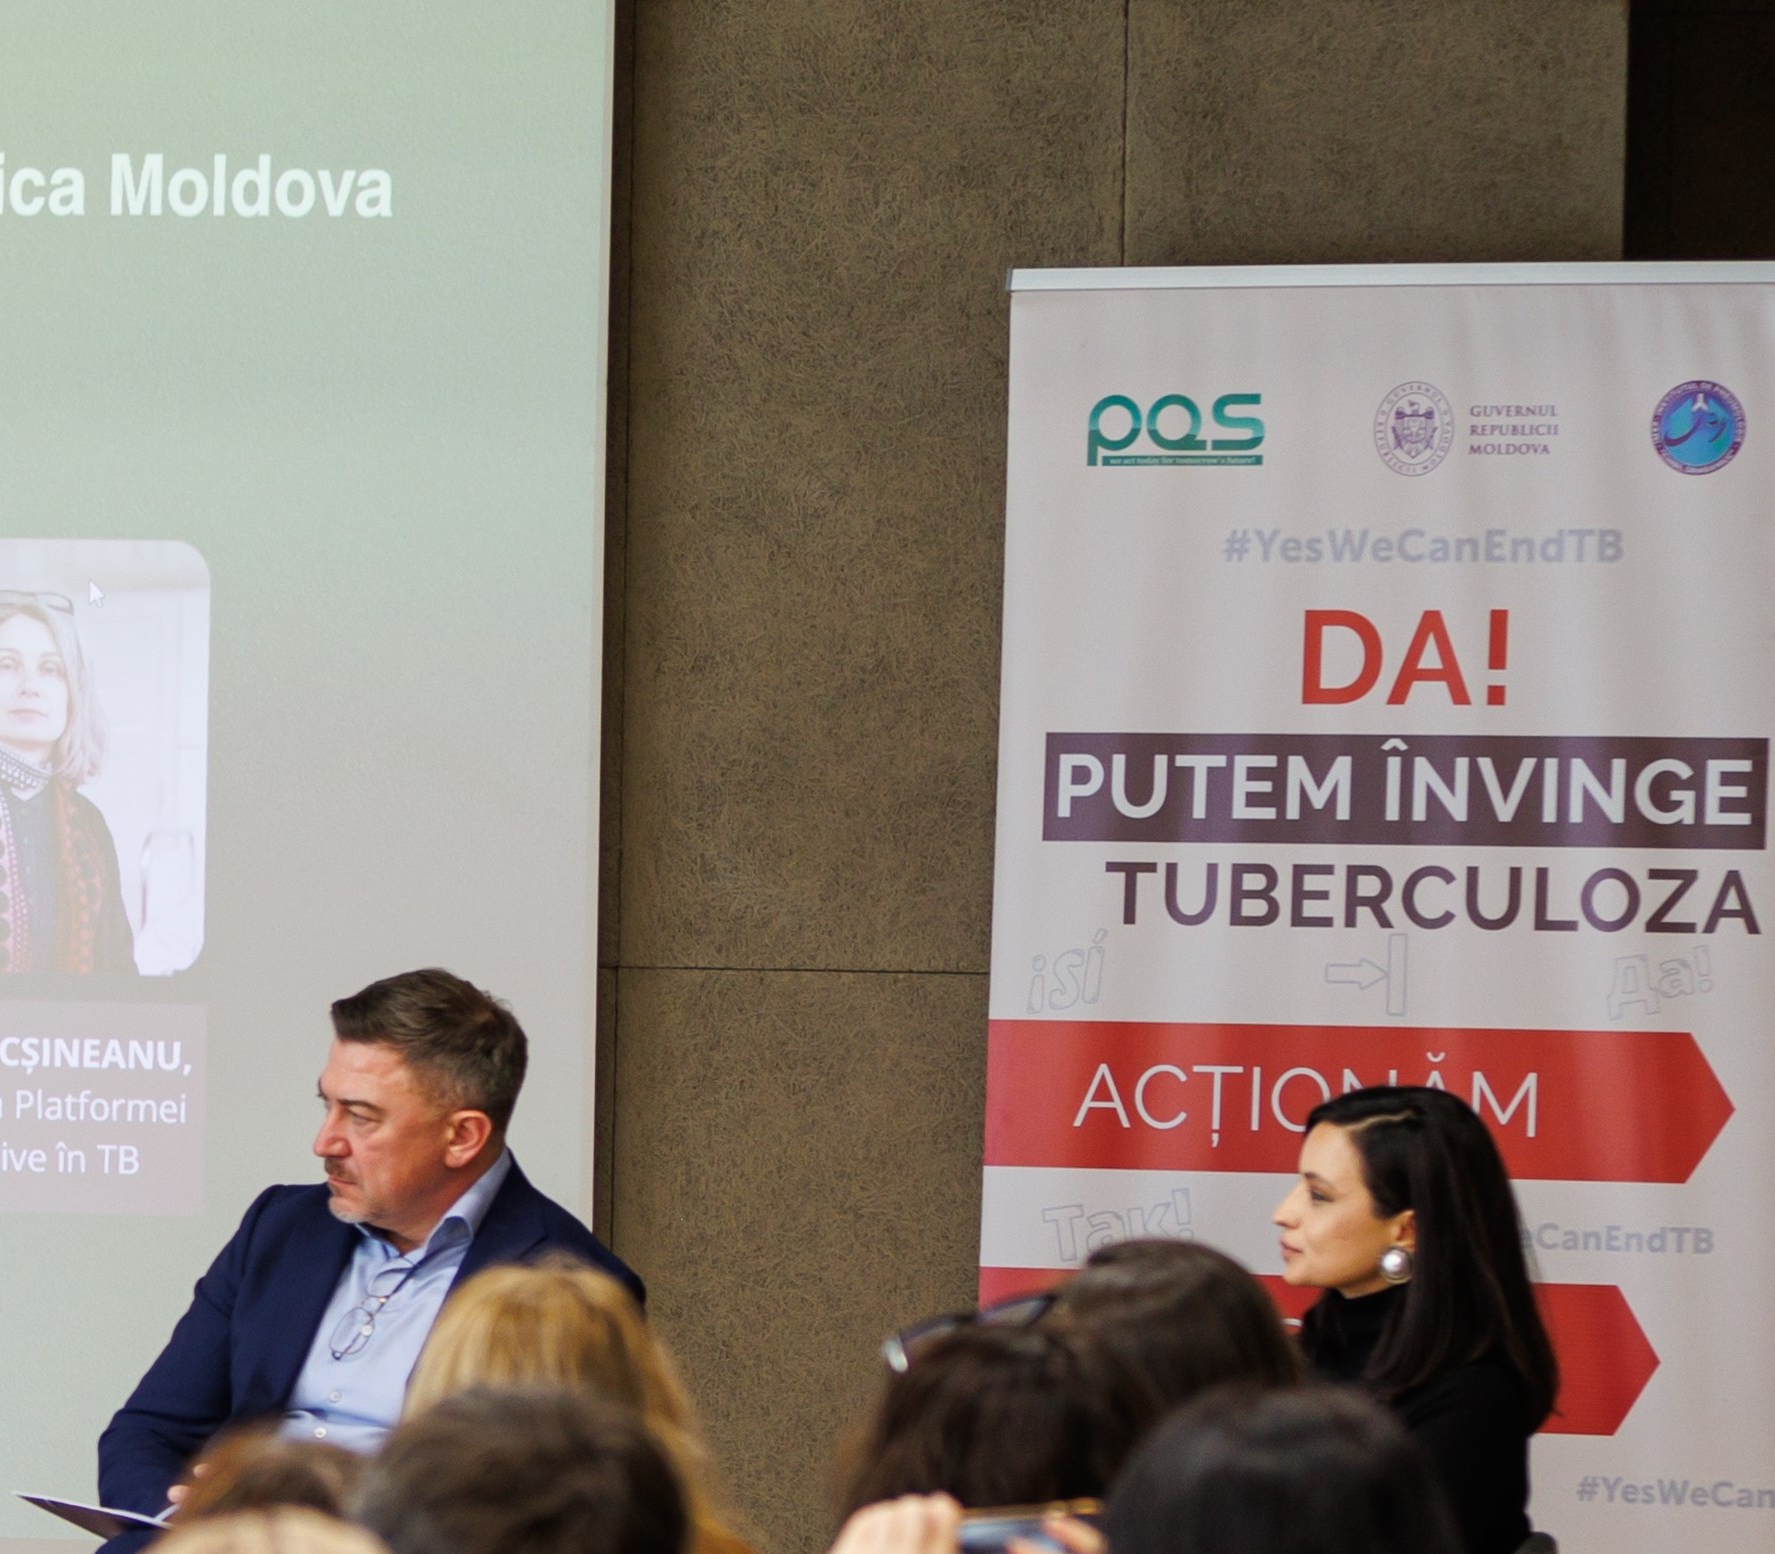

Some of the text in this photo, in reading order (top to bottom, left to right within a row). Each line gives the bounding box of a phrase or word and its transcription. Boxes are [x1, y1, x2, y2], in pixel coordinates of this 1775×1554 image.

[109, 153, 394, 218] Moldova
[1469, 404, 1559, 418] GUVERNUL
[1469, 424, 1560, 437] REPUBLICII
[1467, 443, 1552, 456] MOLDOVA
[1223, 529, 1626, 565] #YesWeCanEndTB
[1300, 609, 1510, 708] DA!
[1055, 738, 1754, 827] PUTEM ÎNVINGE
[1105, 861, 1763, 936] TUBERCULOZA
[1605, 944, 1714, 1020] Да!
[15, 1089, 187, 1124] Platformei
[55, 1141, 86, 1174] în
[96, 1144, 140, 1176] TB
